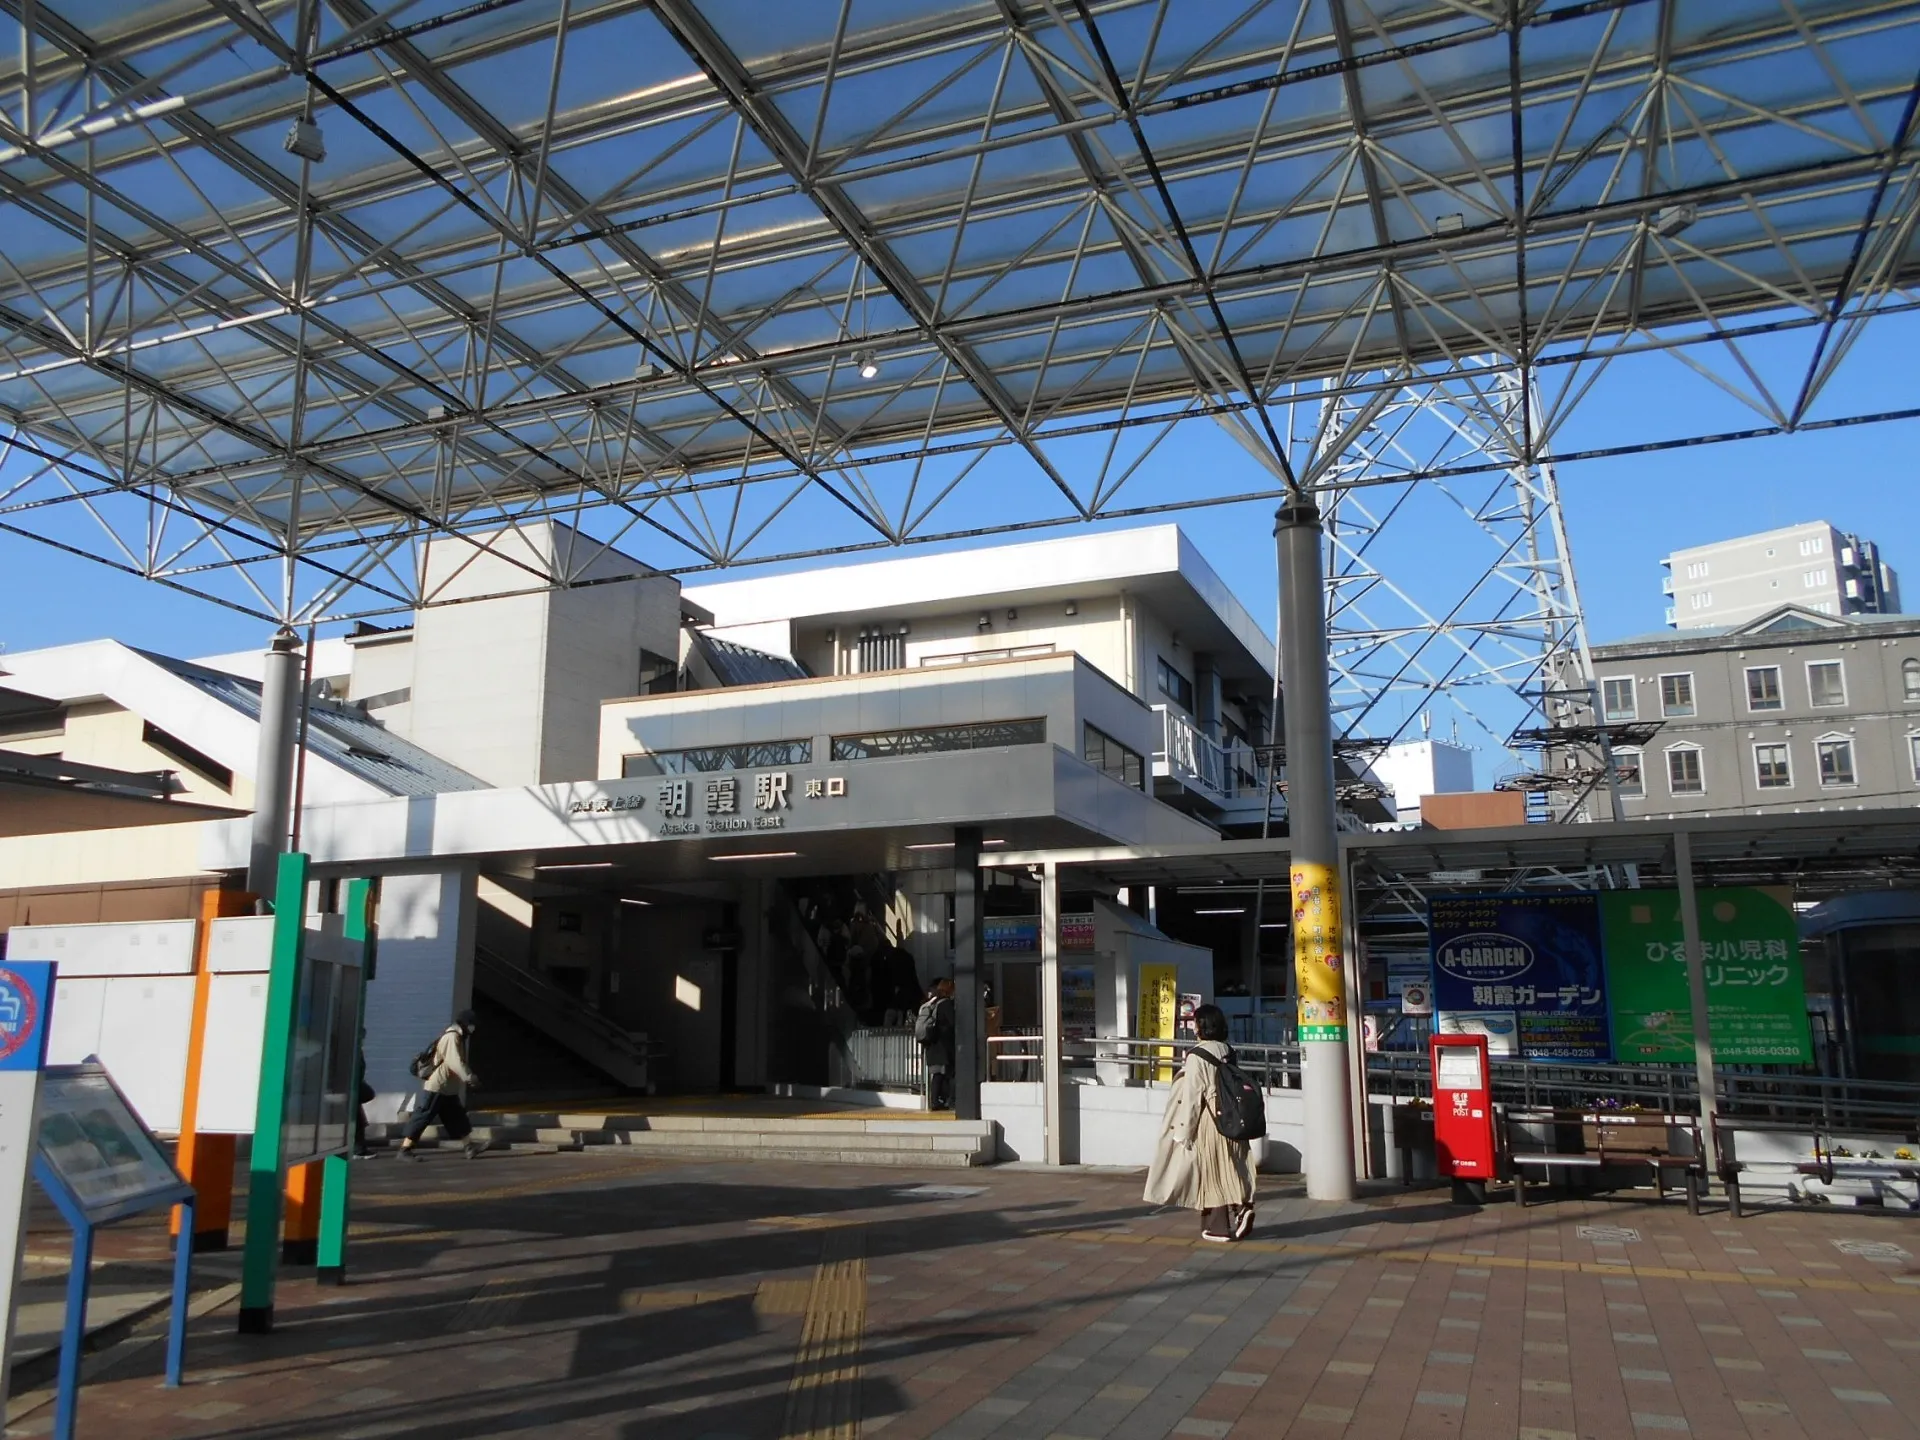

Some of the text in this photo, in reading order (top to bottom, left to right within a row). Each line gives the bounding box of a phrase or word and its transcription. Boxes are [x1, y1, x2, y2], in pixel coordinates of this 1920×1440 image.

[656, 771, 789, 817] 朝霞駅
[804, 777, 845, 798] 東口
[660, 815, 782, 835] Asaka Station East
[1444, 947, 1525, 967] A-GARDEN
[1160, 972, 1170, 1026] ふれあいで
[1472, 985, 1601, 1005] 朝霞ガーデン
[1453, 1107, 1469, 1116] POST
